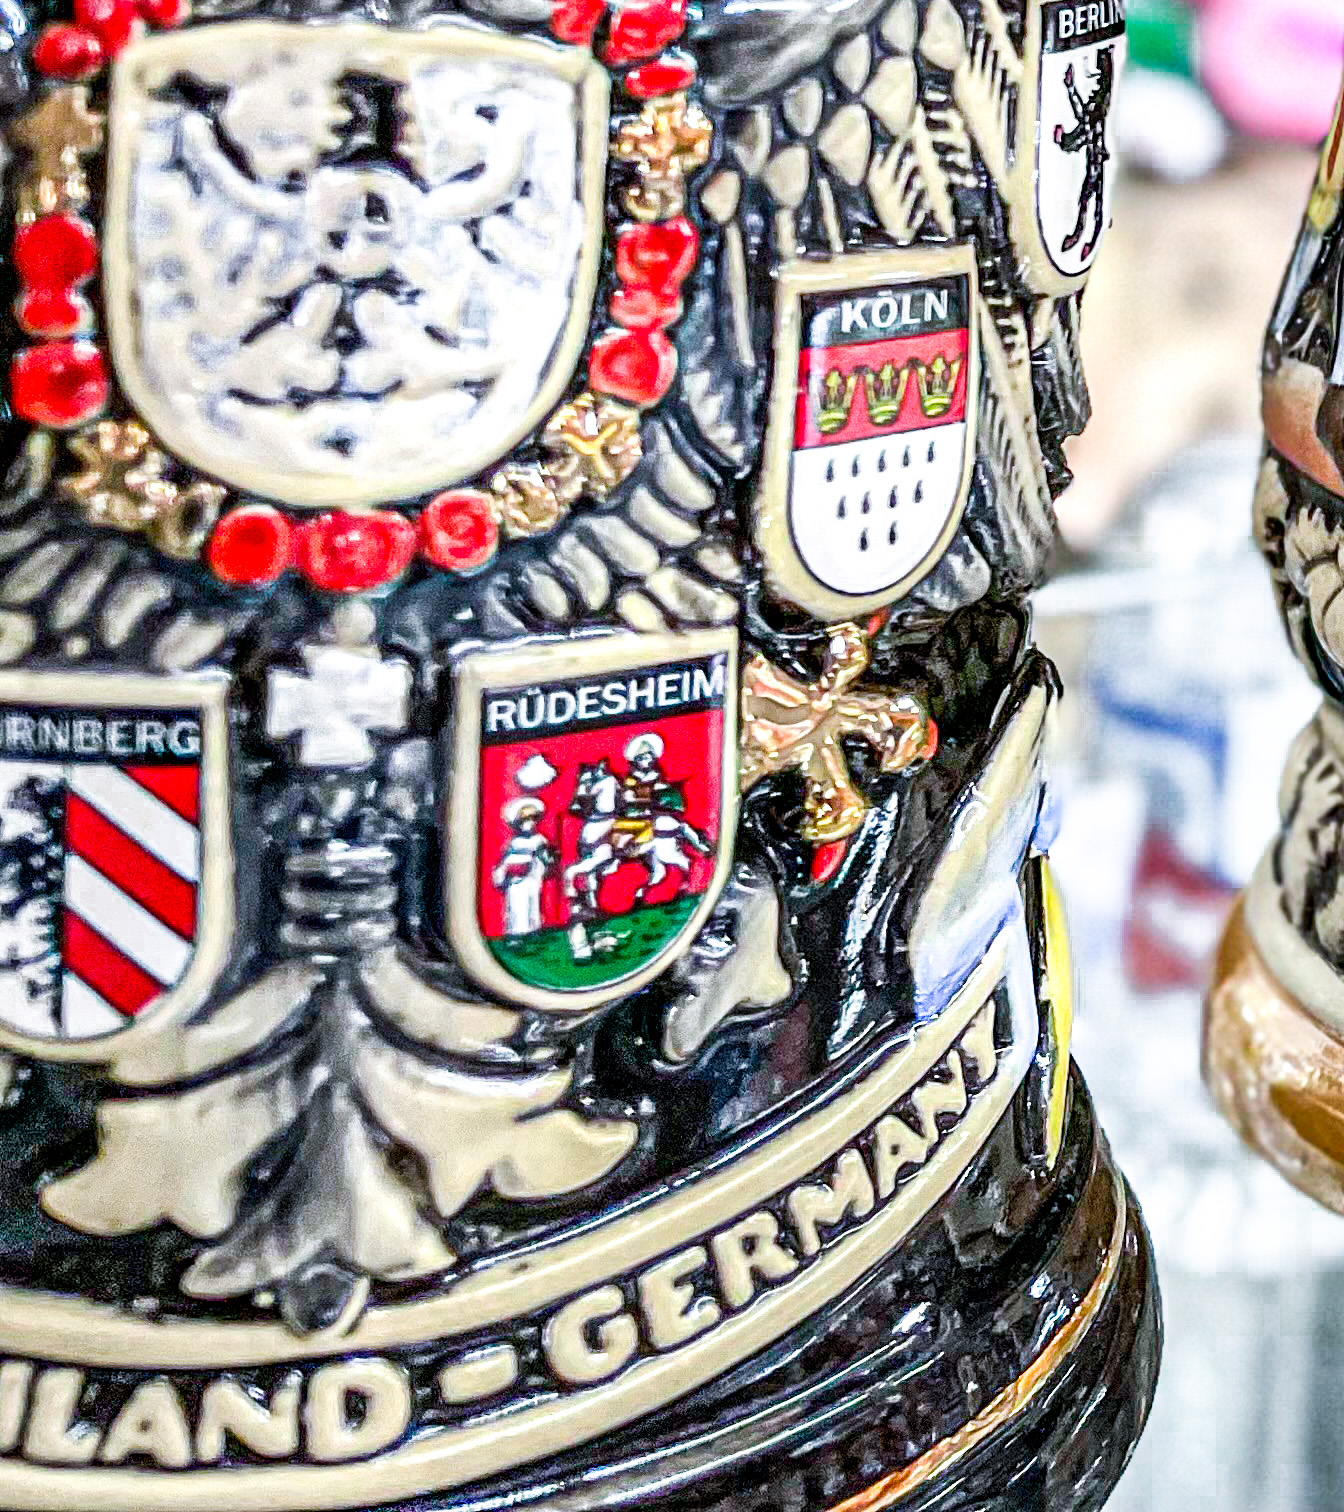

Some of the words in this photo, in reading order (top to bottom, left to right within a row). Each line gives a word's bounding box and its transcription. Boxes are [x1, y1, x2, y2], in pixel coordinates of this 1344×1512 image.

[840, 289, 949, 334] KÖLN
[486, 663, 727, 733] RÜDESHEIM
[543, 995, 998, 1386] GERMANY
